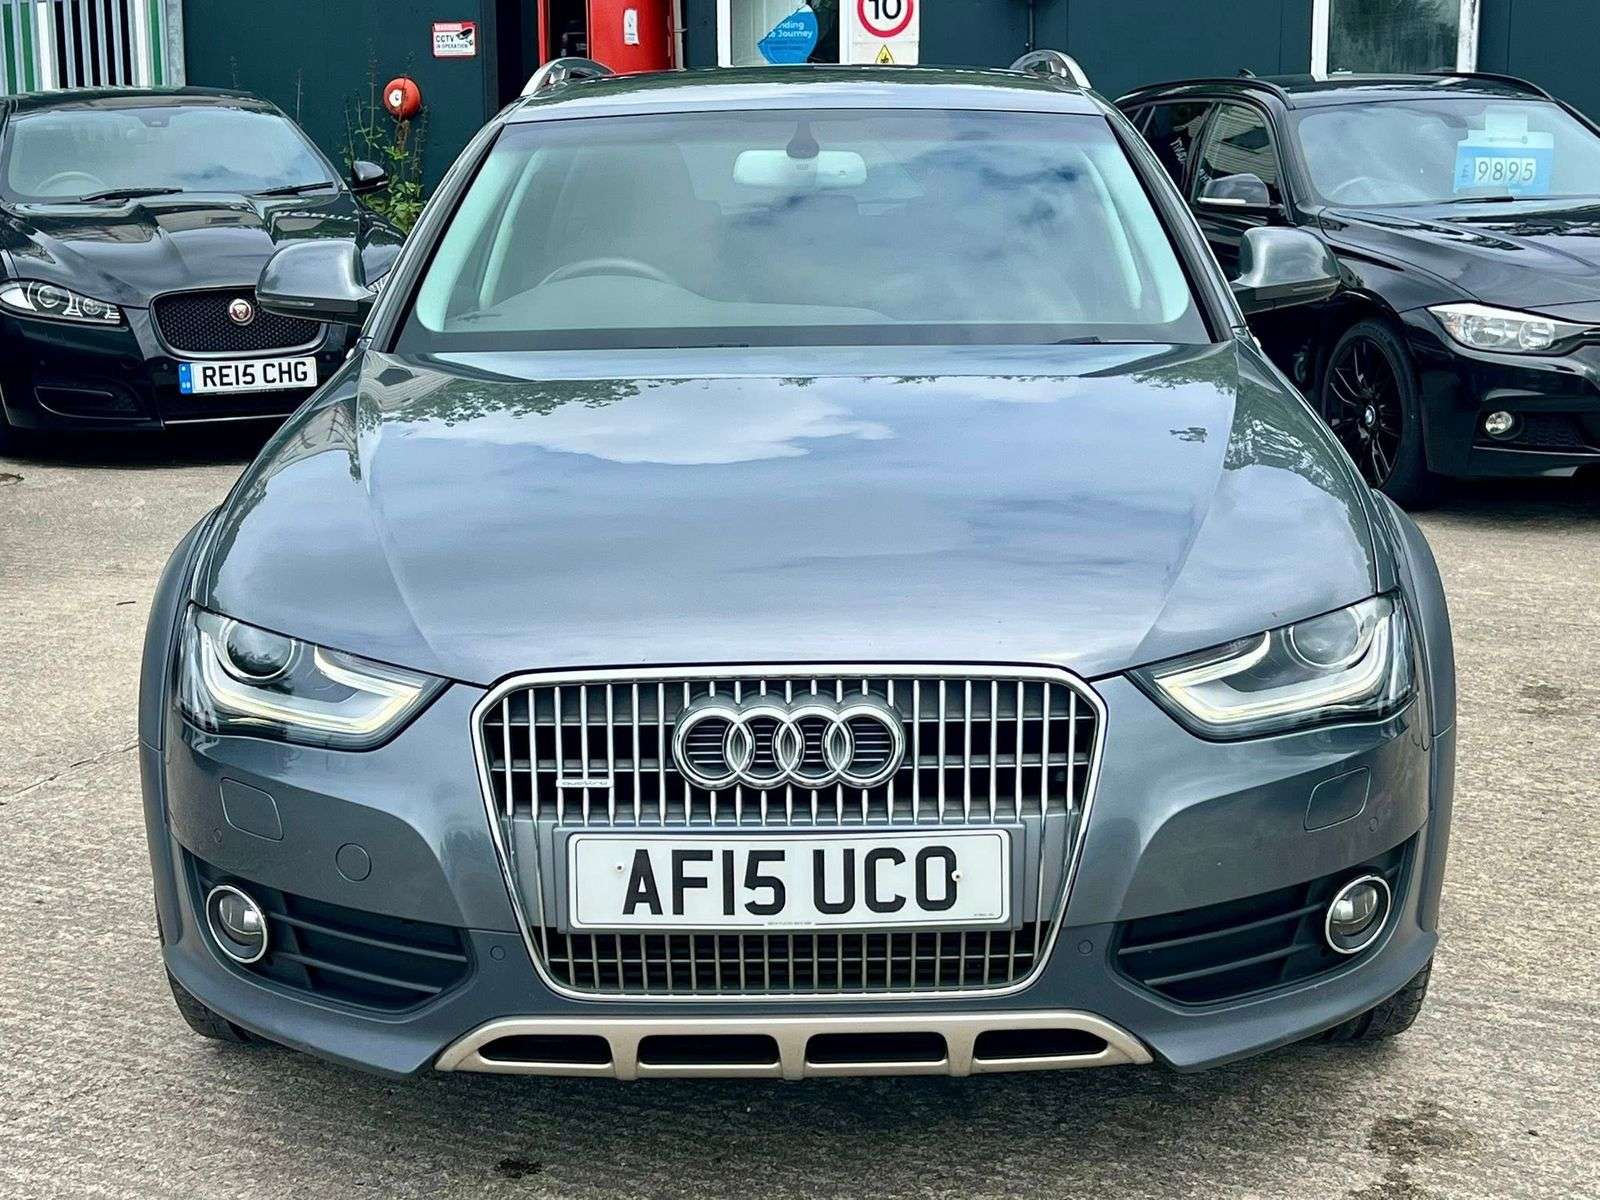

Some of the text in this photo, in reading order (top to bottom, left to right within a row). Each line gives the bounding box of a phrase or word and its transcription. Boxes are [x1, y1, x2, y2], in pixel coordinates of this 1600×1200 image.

[868, 0, 902, 20] 10
[778, 21, 805, 30] nding
[778, 30, 813, 39] Journey
[435, 34, 455, 43] CCTV
[1478, 160, 1533, 182] 9895
[202, 361, 308, 387] RE15 CHG
[622, 846, 958, 916] AF15 UCO
